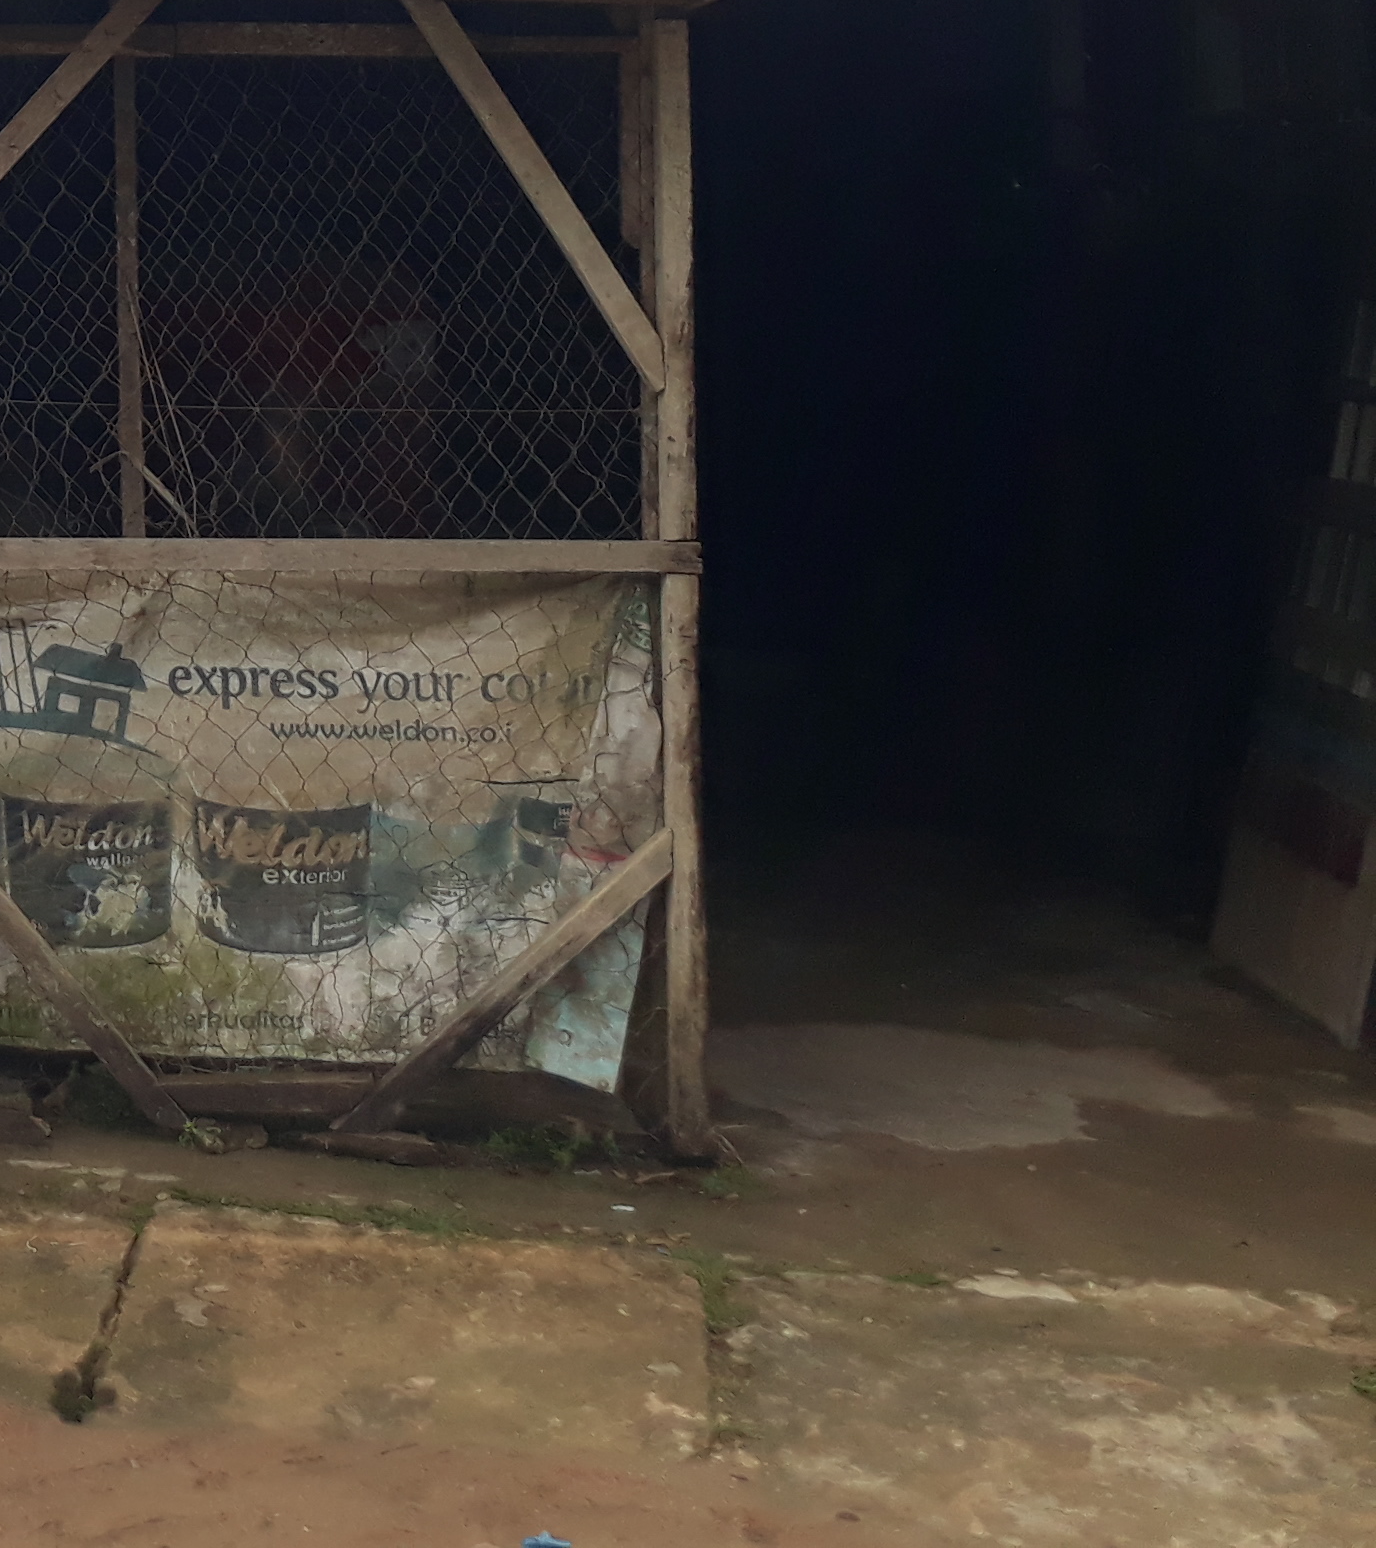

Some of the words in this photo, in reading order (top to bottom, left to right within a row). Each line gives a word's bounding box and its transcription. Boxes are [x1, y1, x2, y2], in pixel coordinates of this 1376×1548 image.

[167, 663, 339, 709] express
[351, 669, 465, 714] your
[19, 809, 155, 851] Weldon
[197, 807, 370, 867] Weldon
[261, 865, 350, 886] exterior
